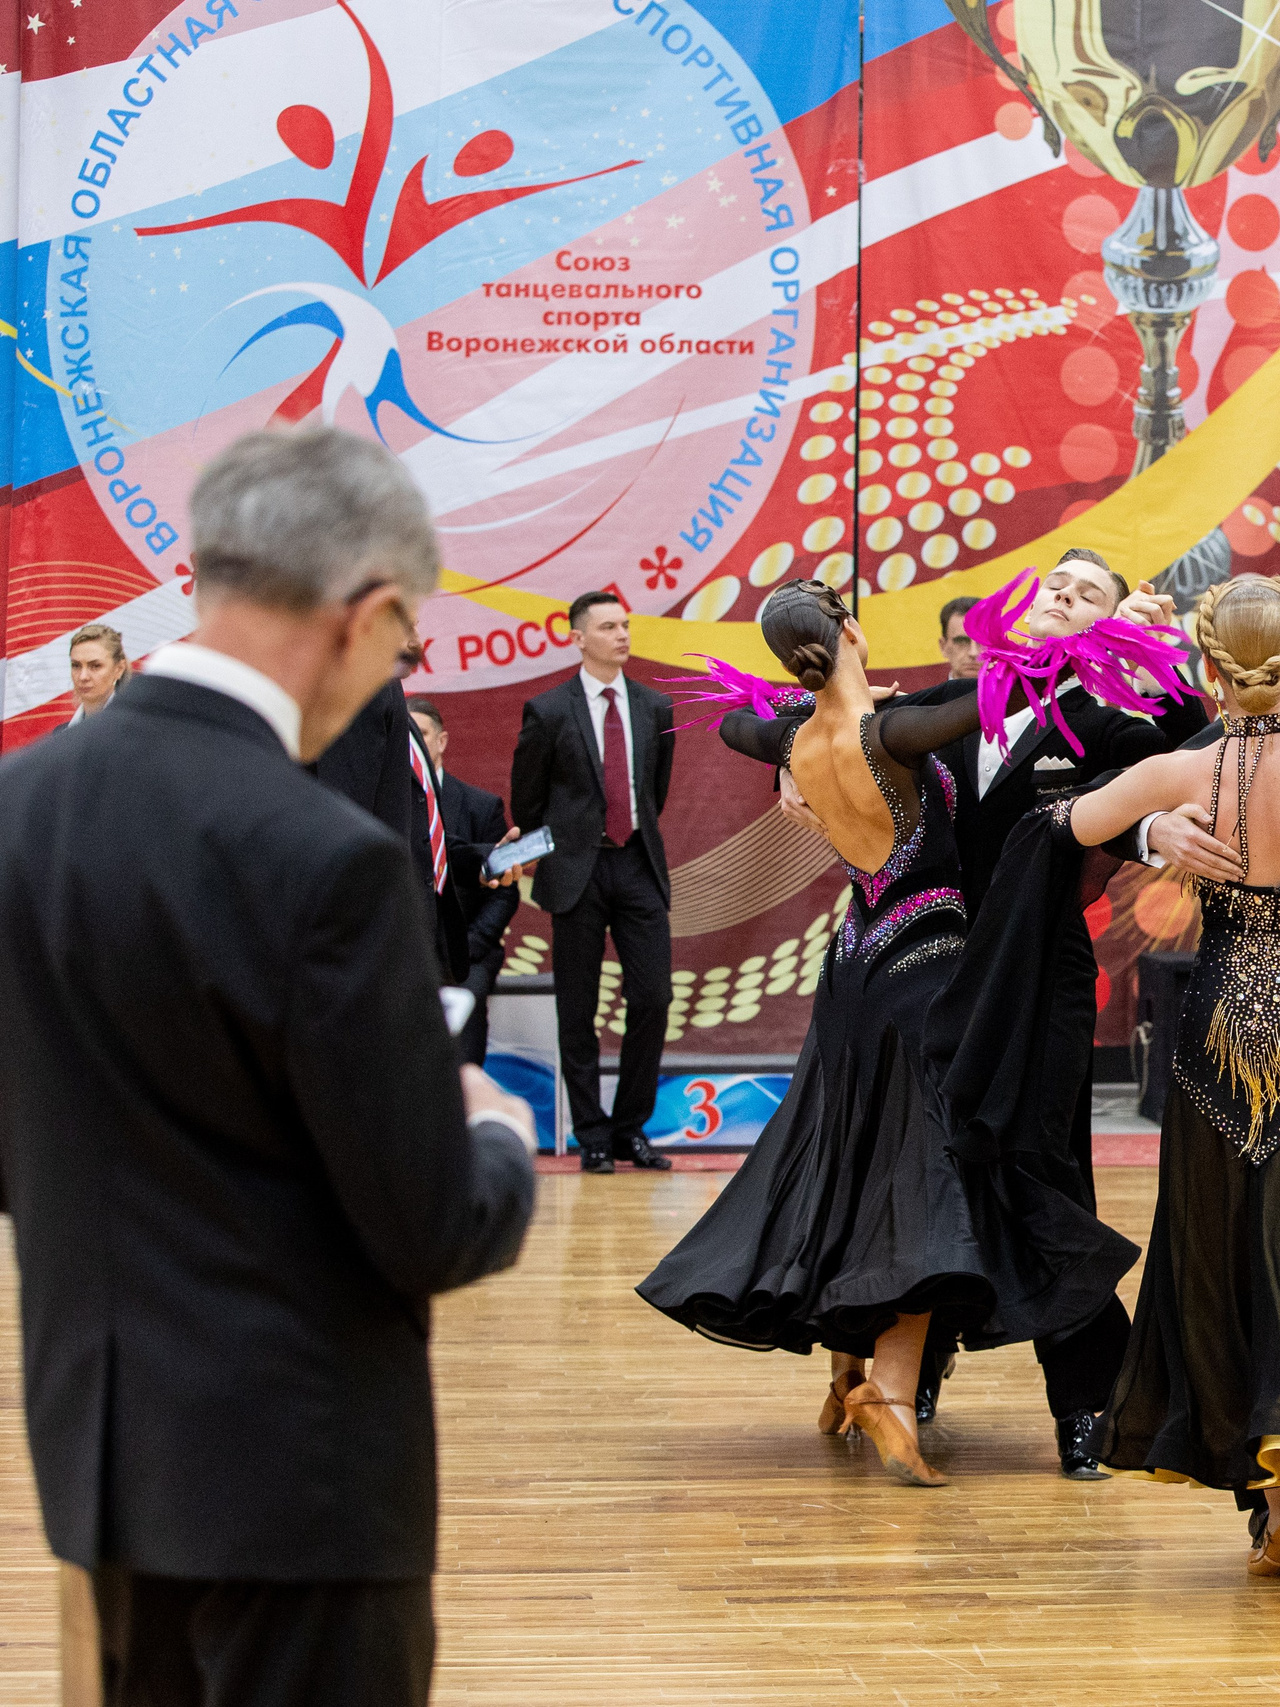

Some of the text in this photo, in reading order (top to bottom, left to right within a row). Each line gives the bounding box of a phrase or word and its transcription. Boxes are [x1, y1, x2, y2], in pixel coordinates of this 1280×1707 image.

[555, 250, 631, 272] Союз
[59, 0, 239, 556] ВОРОНЕЖСКАЯ ОБЛАСТНАЯ
[482, 283, 702, 301] танцевального
[543, 310, 642, 331] спорта
[427, 331, 754, 357] Воронежской области
[678, 246, 800, 553] ОРГАНИЗАЦИЯ
[684, 1079, 722, 1139] 3
